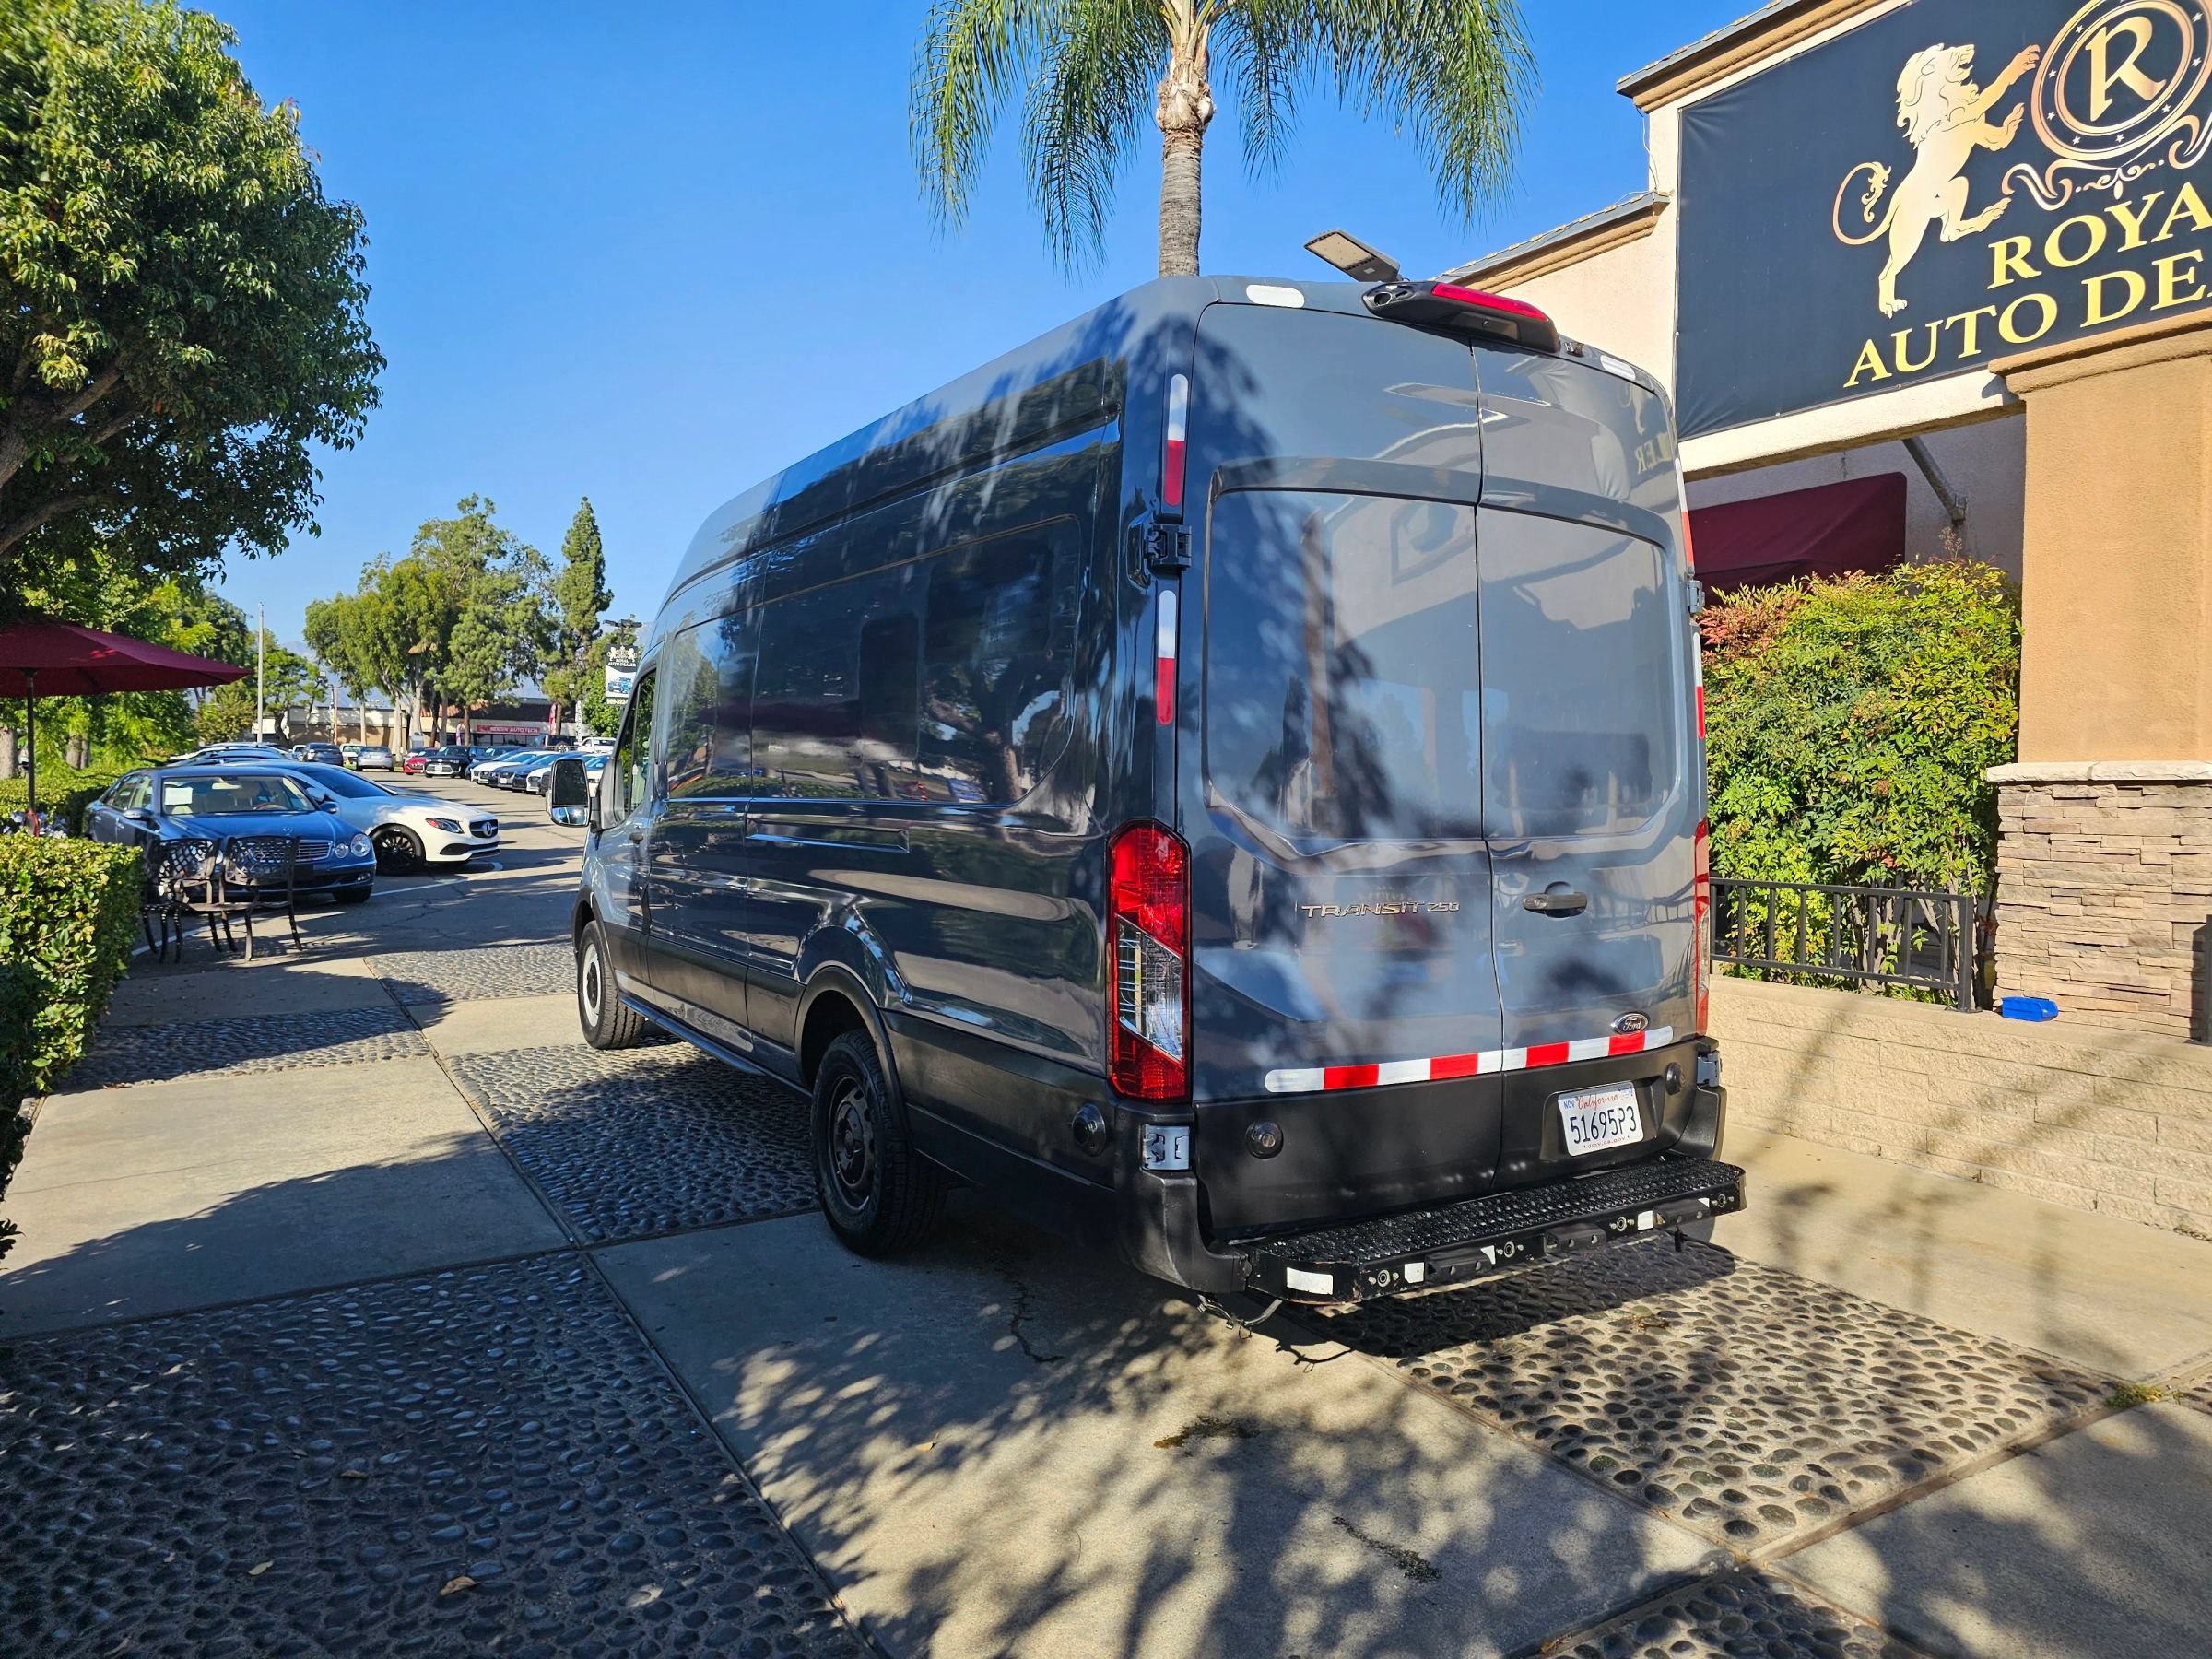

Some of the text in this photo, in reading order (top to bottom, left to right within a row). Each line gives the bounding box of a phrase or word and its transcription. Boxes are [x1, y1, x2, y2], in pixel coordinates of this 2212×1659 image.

[2085, 16, 2167, 122] R
[1843, 249, 2212, 388] AUTO DE
[1301, 901, 1460, 918] TRANSIT 250
[1622, 1018, 1642, 1031] Ford
[1563, 1100, 1575, 1109] NOV
[1577, 1093, 1622, 1111] California
[1570, 1105, 1637, 1144] 51695P3
